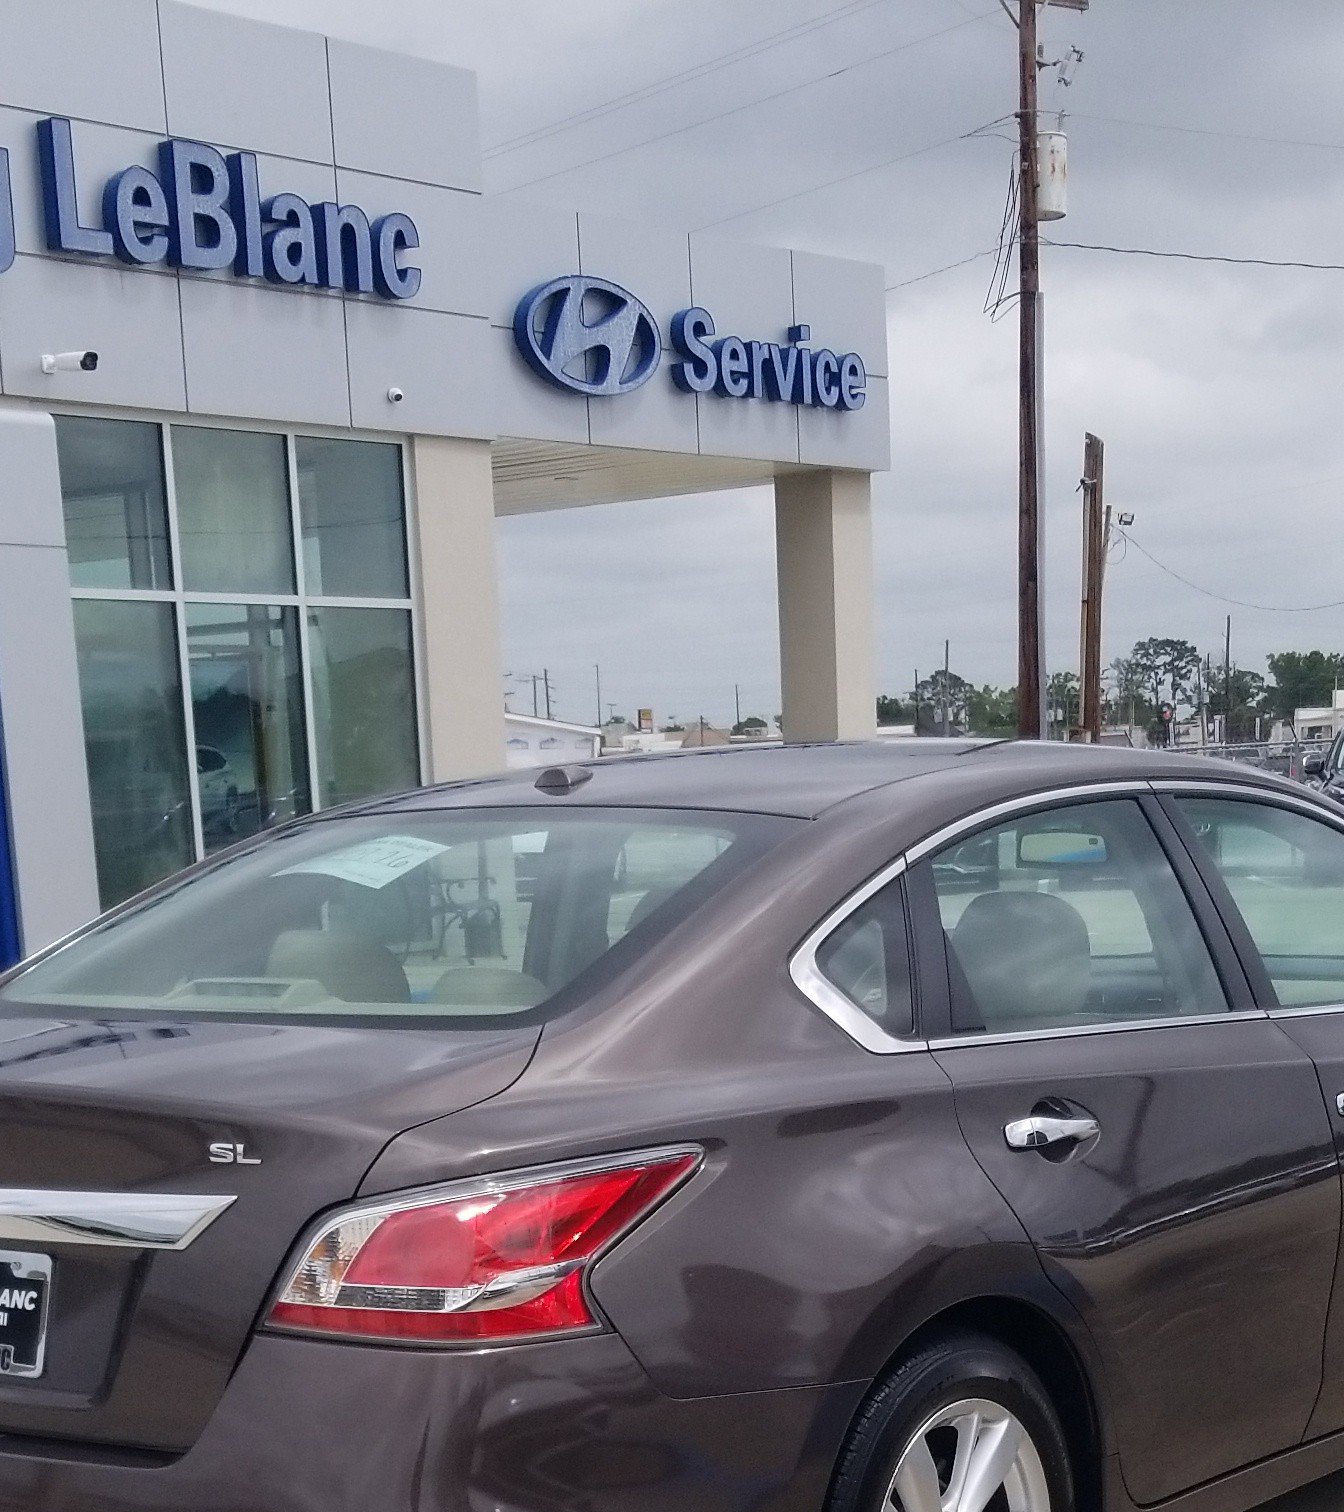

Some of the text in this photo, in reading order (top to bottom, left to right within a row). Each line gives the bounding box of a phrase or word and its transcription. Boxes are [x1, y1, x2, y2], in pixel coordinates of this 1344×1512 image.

[37, 116, 422, 299] LeBlanc
[670, 306, 867, 411] Service
[208, 1143, 262, 1165] SL
